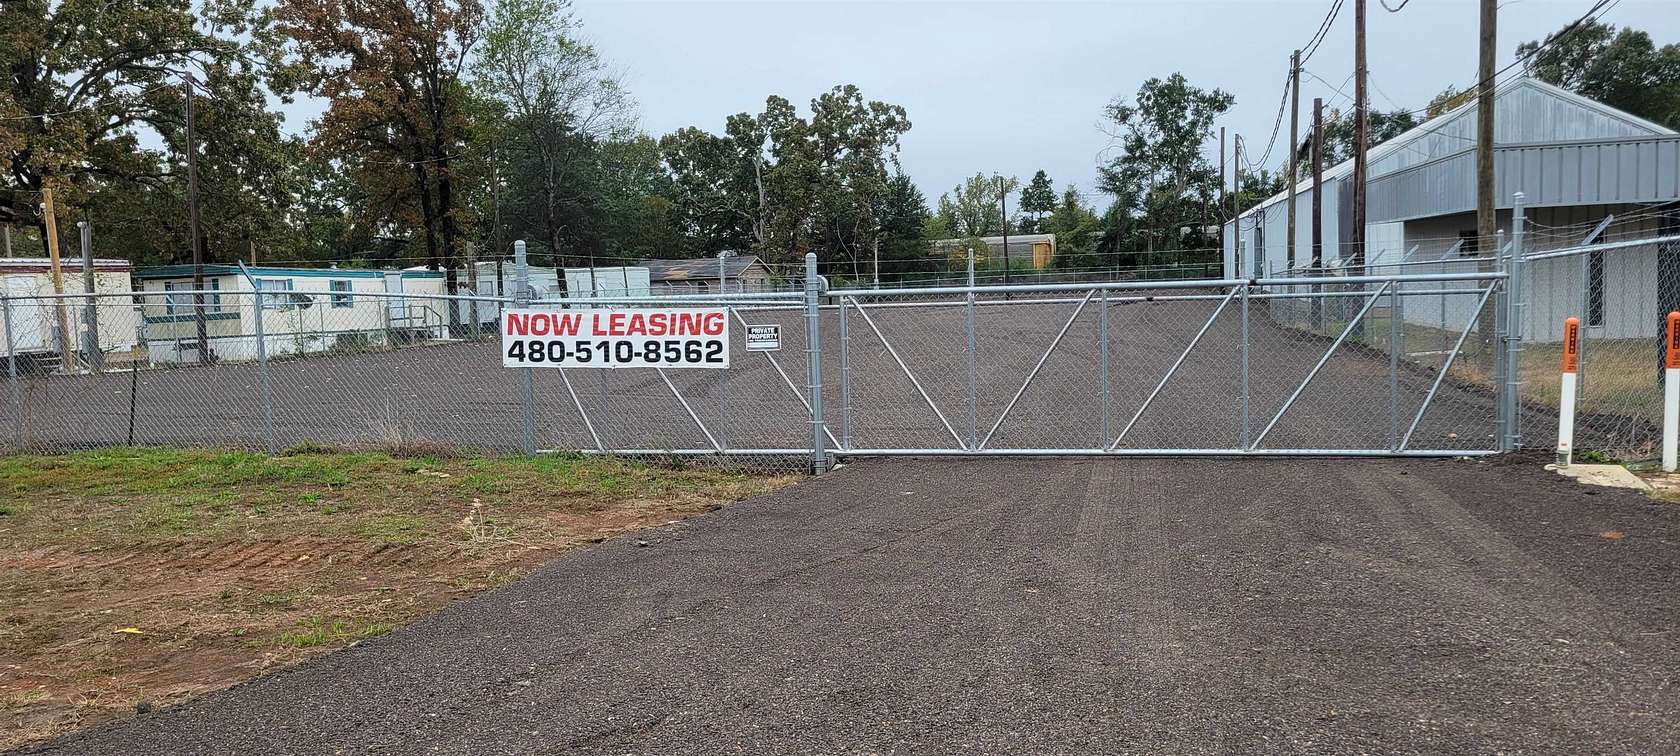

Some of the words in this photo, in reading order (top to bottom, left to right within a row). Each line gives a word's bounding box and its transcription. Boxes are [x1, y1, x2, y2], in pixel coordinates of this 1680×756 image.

[507, 313, 583, 336] NOW
[591, 312, 725, 336] LEASING
[507, 340, 724, 363] 480-510-8562
